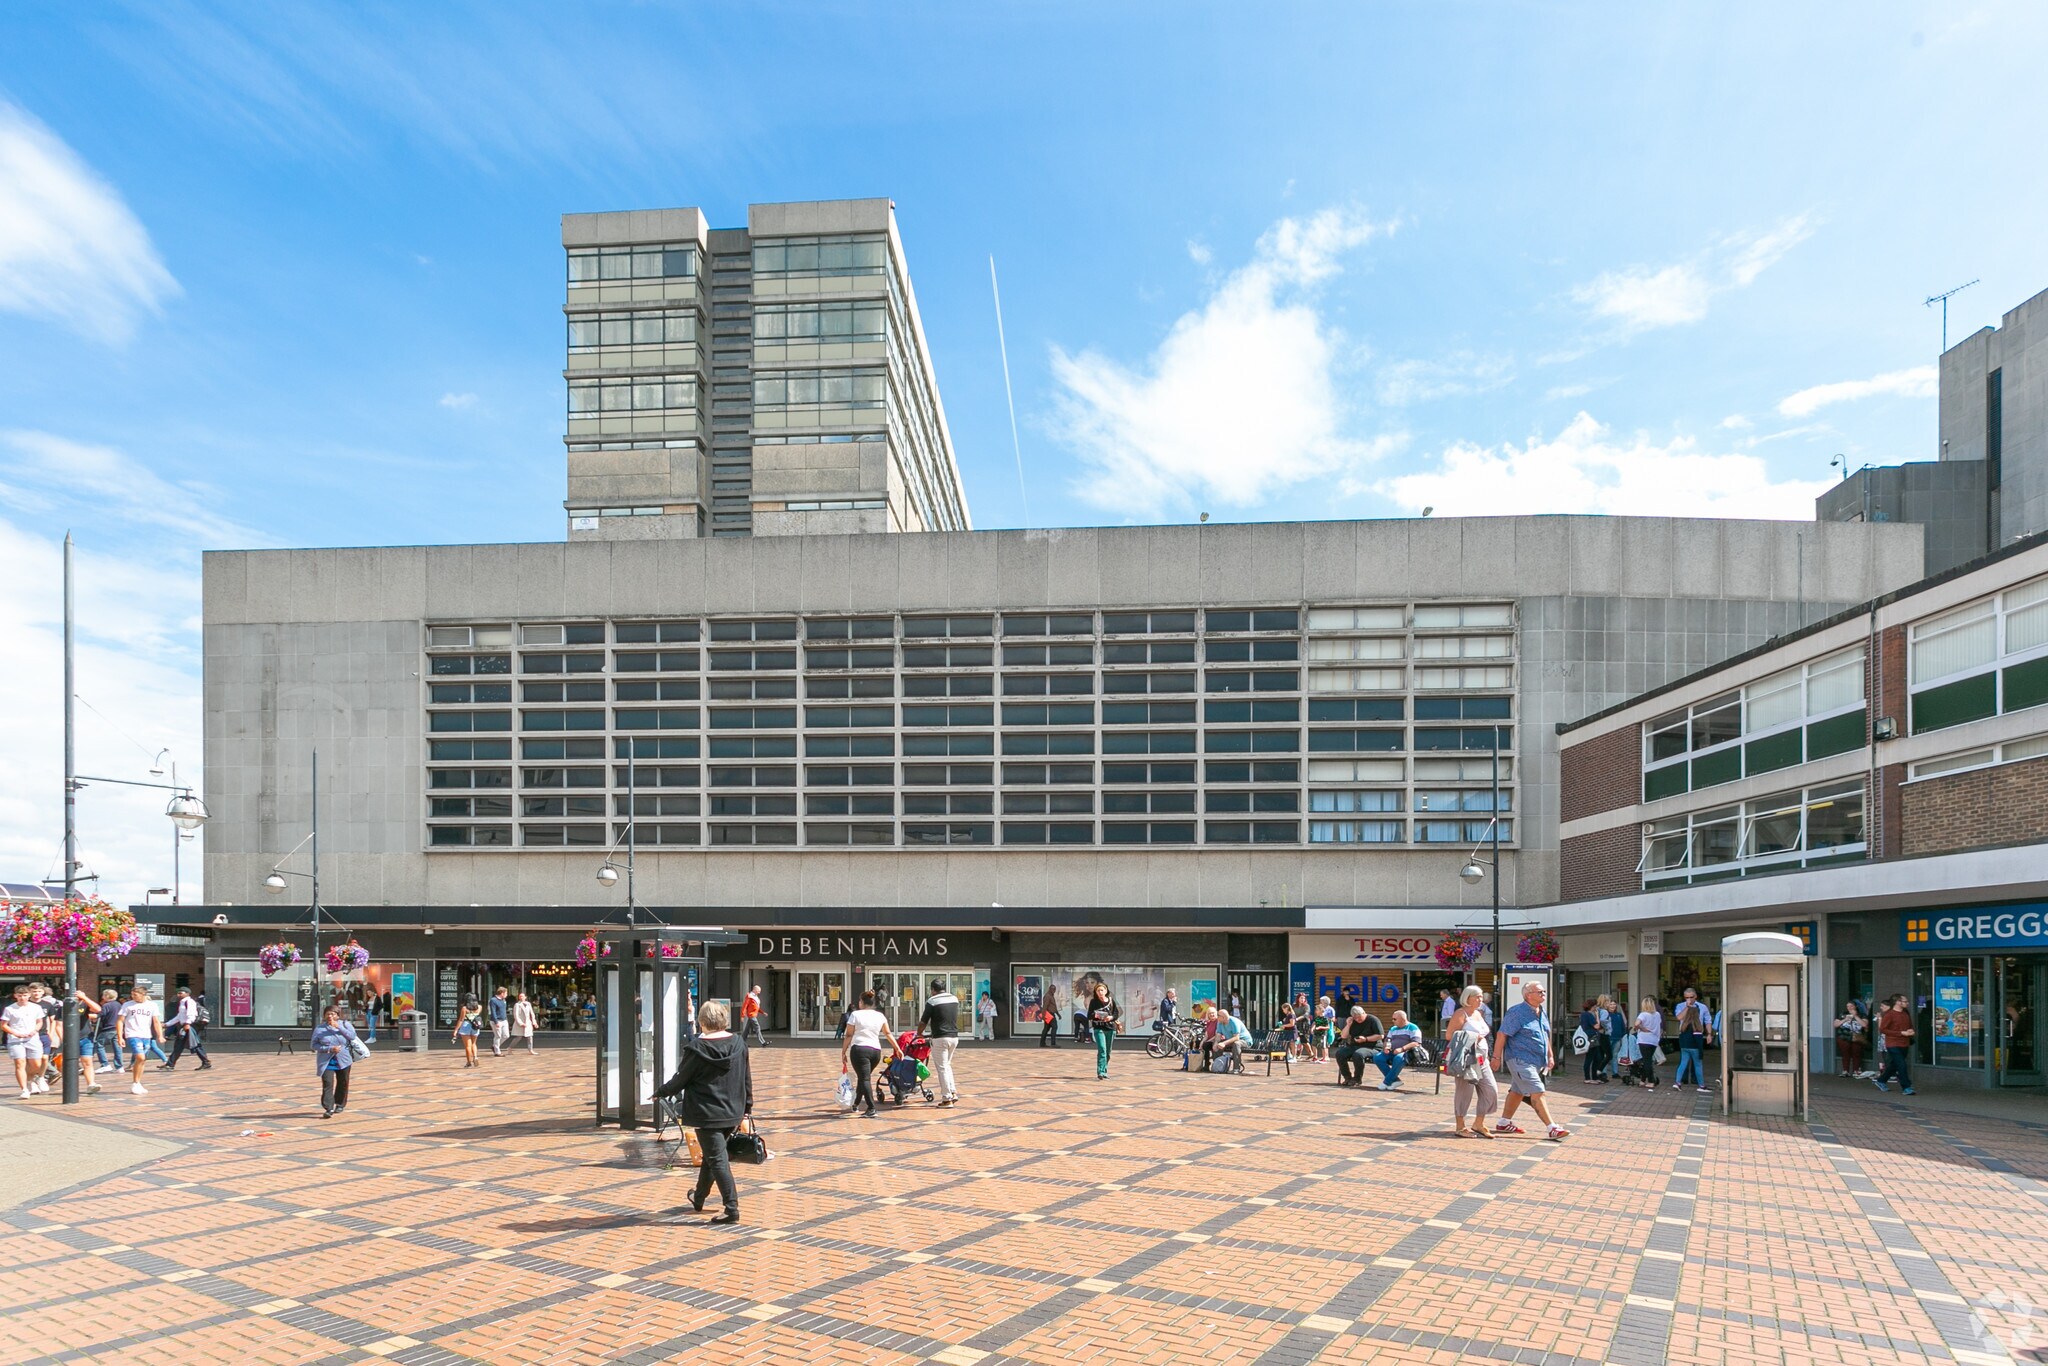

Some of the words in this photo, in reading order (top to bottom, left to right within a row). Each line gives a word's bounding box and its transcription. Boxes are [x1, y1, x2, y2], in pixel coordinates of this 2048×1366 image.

[161, 927, 211, 937] DEBENHAMS
[758, 937, 948, 956] DEBENHAMS
[1355, 938, 1431, 953] TESCO
[1318, 975, 1400, 1004] Hello
[131, 1008, 151, 1017] POLO
